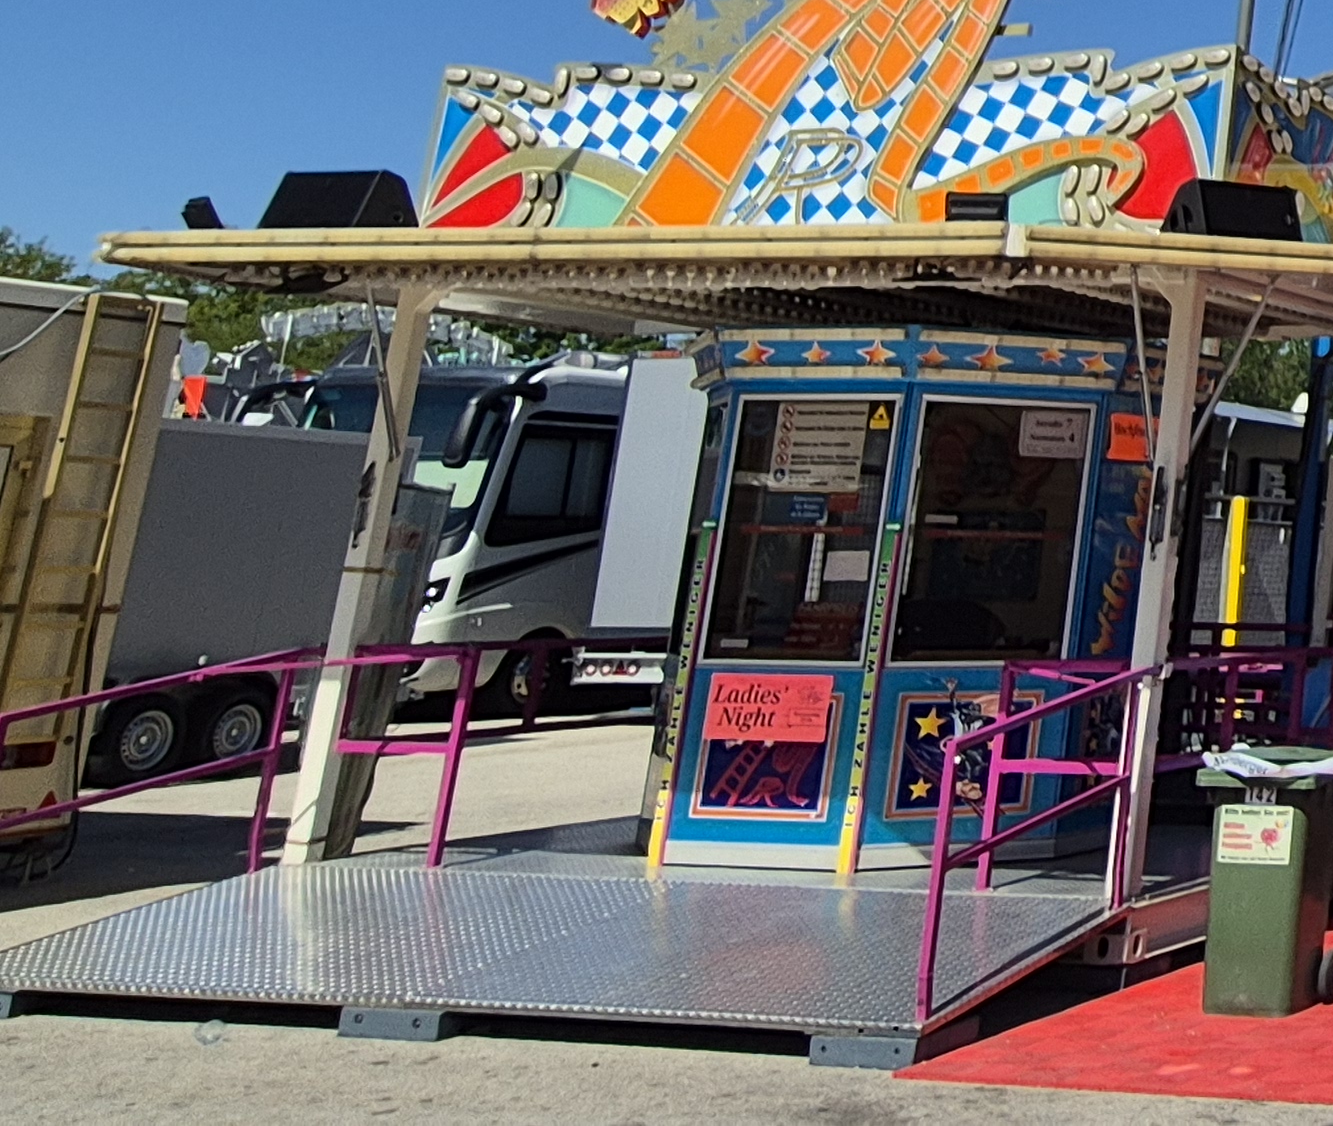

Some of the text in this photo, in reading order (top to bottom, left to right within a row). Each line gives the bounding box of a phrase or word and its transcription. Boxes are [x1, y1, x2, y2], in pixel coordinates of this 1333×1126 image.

[712, 683, 789, 705] Ladies'
[844, 562, 891, 827] ICH ZAHLE WENIGER
[717, 705, 777, 732] Night
